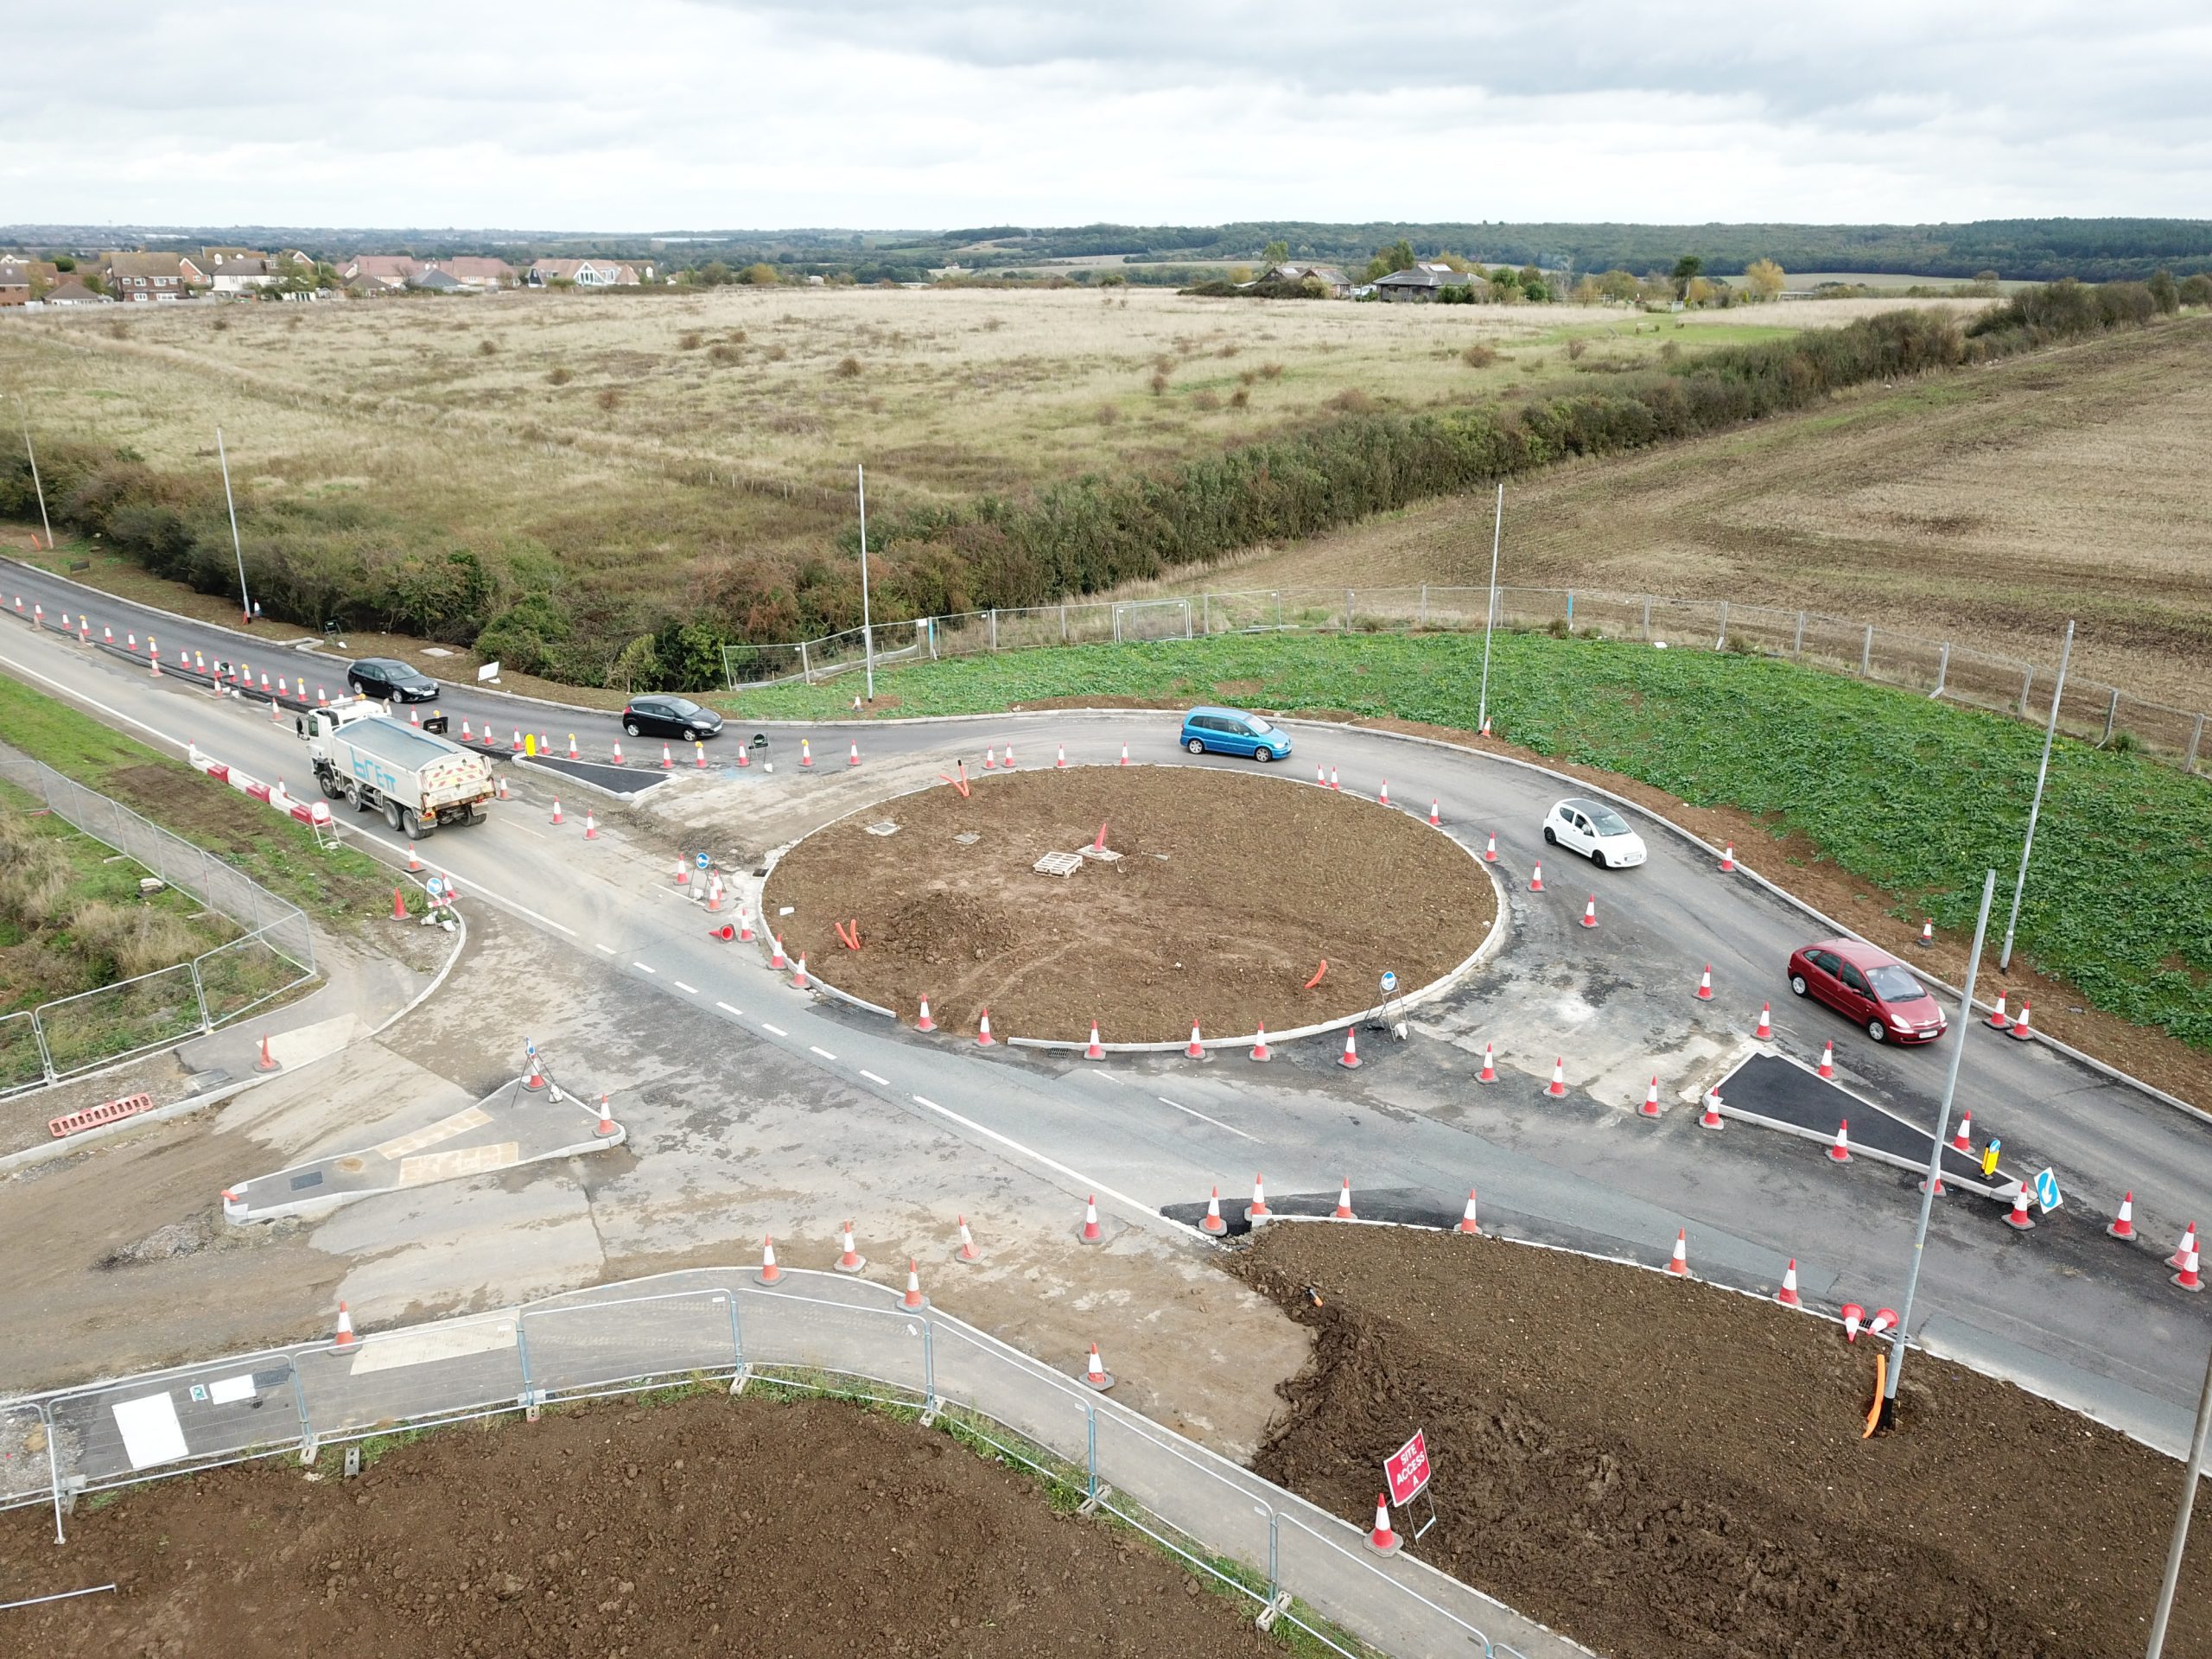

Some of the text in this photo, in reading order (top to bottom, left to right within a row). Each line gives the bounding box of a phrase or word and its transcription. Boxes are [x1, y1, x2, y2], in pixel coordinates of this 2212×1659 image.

[1400, 1443, 1417, 1465] SITE
[1396, 1451, 1425, 1485] ACCESS
[1413, 1475, 1420, 1487] A
